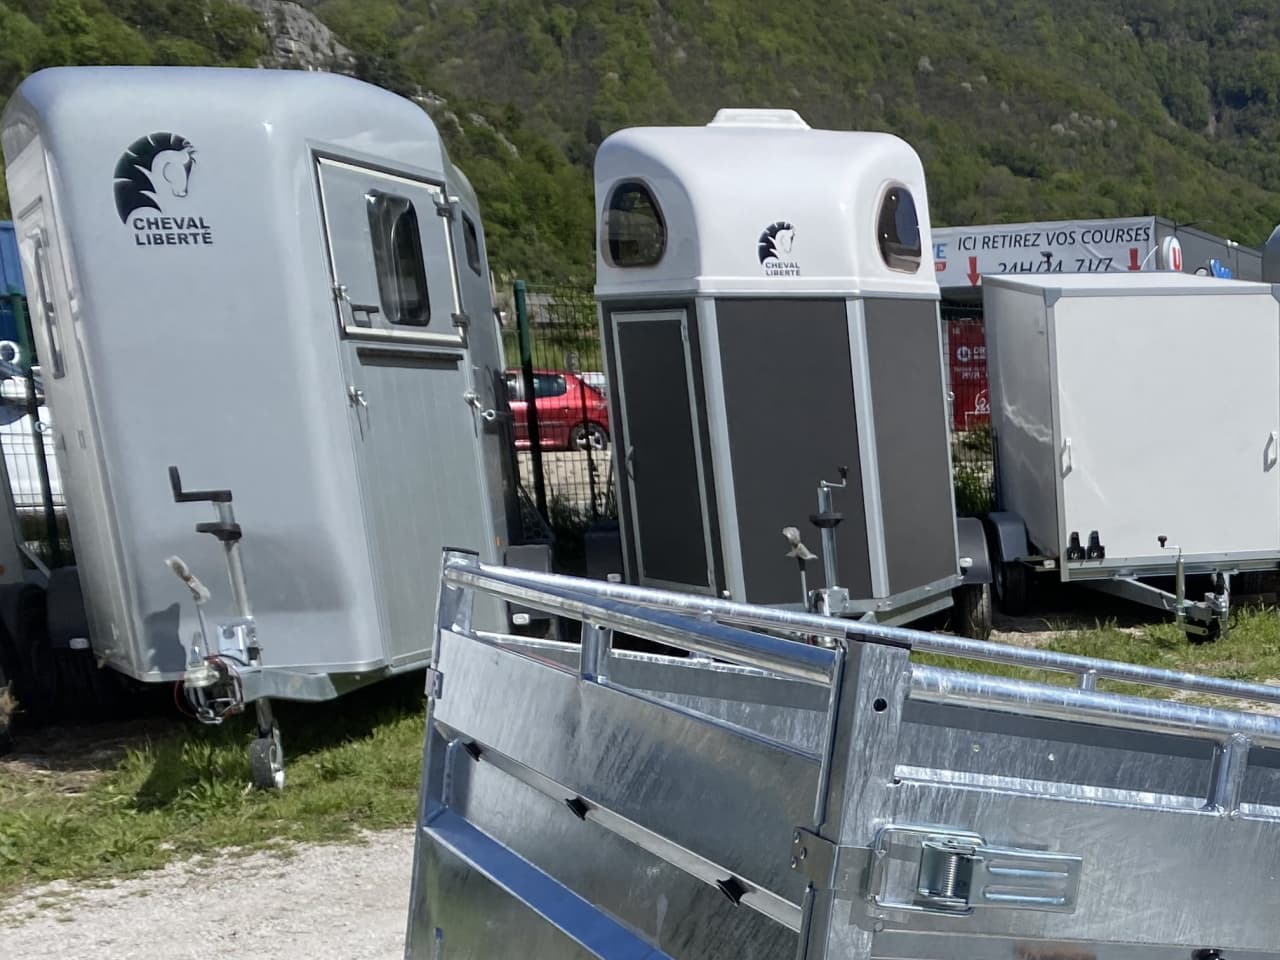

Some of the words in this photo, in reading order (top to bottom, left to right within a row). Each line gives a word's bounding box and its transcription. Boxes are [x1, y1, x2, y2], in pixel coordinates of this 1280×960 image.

[133, 216, 211, 230] CHEVAL
[134, 229, 213, 245] LIBERTÉ
[958, 236, 977, 251] ICI
[981, 233, 1041, 250] RETIREZ
[1046, 230, 1077, 246] VOS
[1081, 227, 1151, 245] COURSES
[765, 261, 800, 269] CHEVAL
